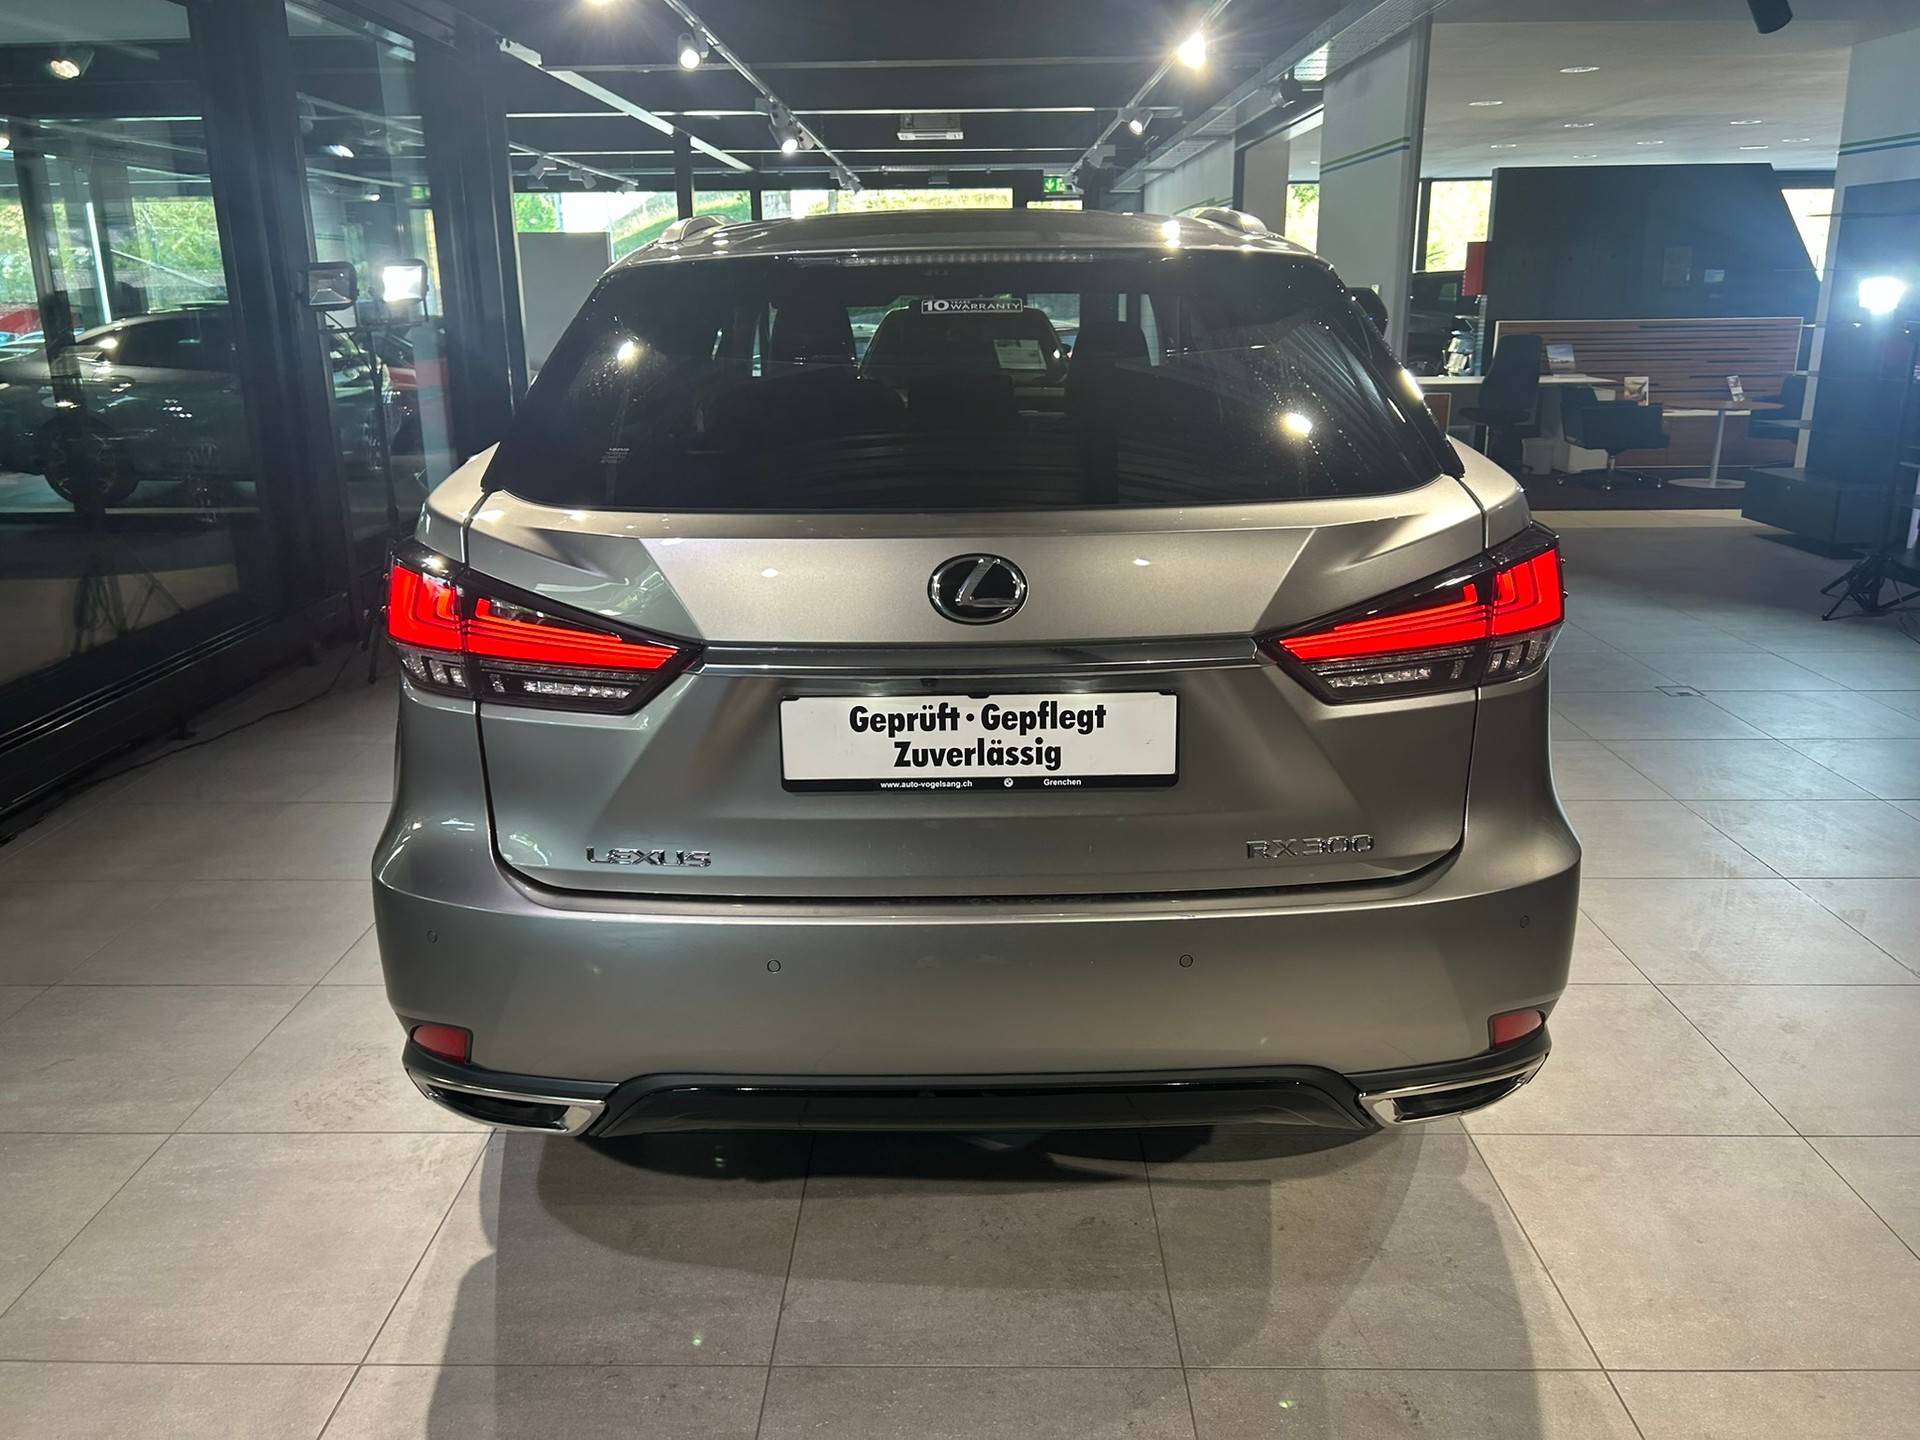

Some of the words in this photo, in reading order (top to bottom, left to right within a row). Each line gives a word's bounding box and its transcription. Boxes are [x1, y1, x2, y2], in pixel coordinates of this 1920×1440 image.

[924, 300, 950, 311] 10
[849, 702, 960, 738] Geprüft
[981, 701, 1107, 734] Gepflegt
[893, 737, 1062, 771] Zuverlässig
[881, 779, 973, 789] www.auto-vogelsang.ch
[1043, 777, 1082, 787] Grenchen
[586, 846, 711, 867] LEXUS
